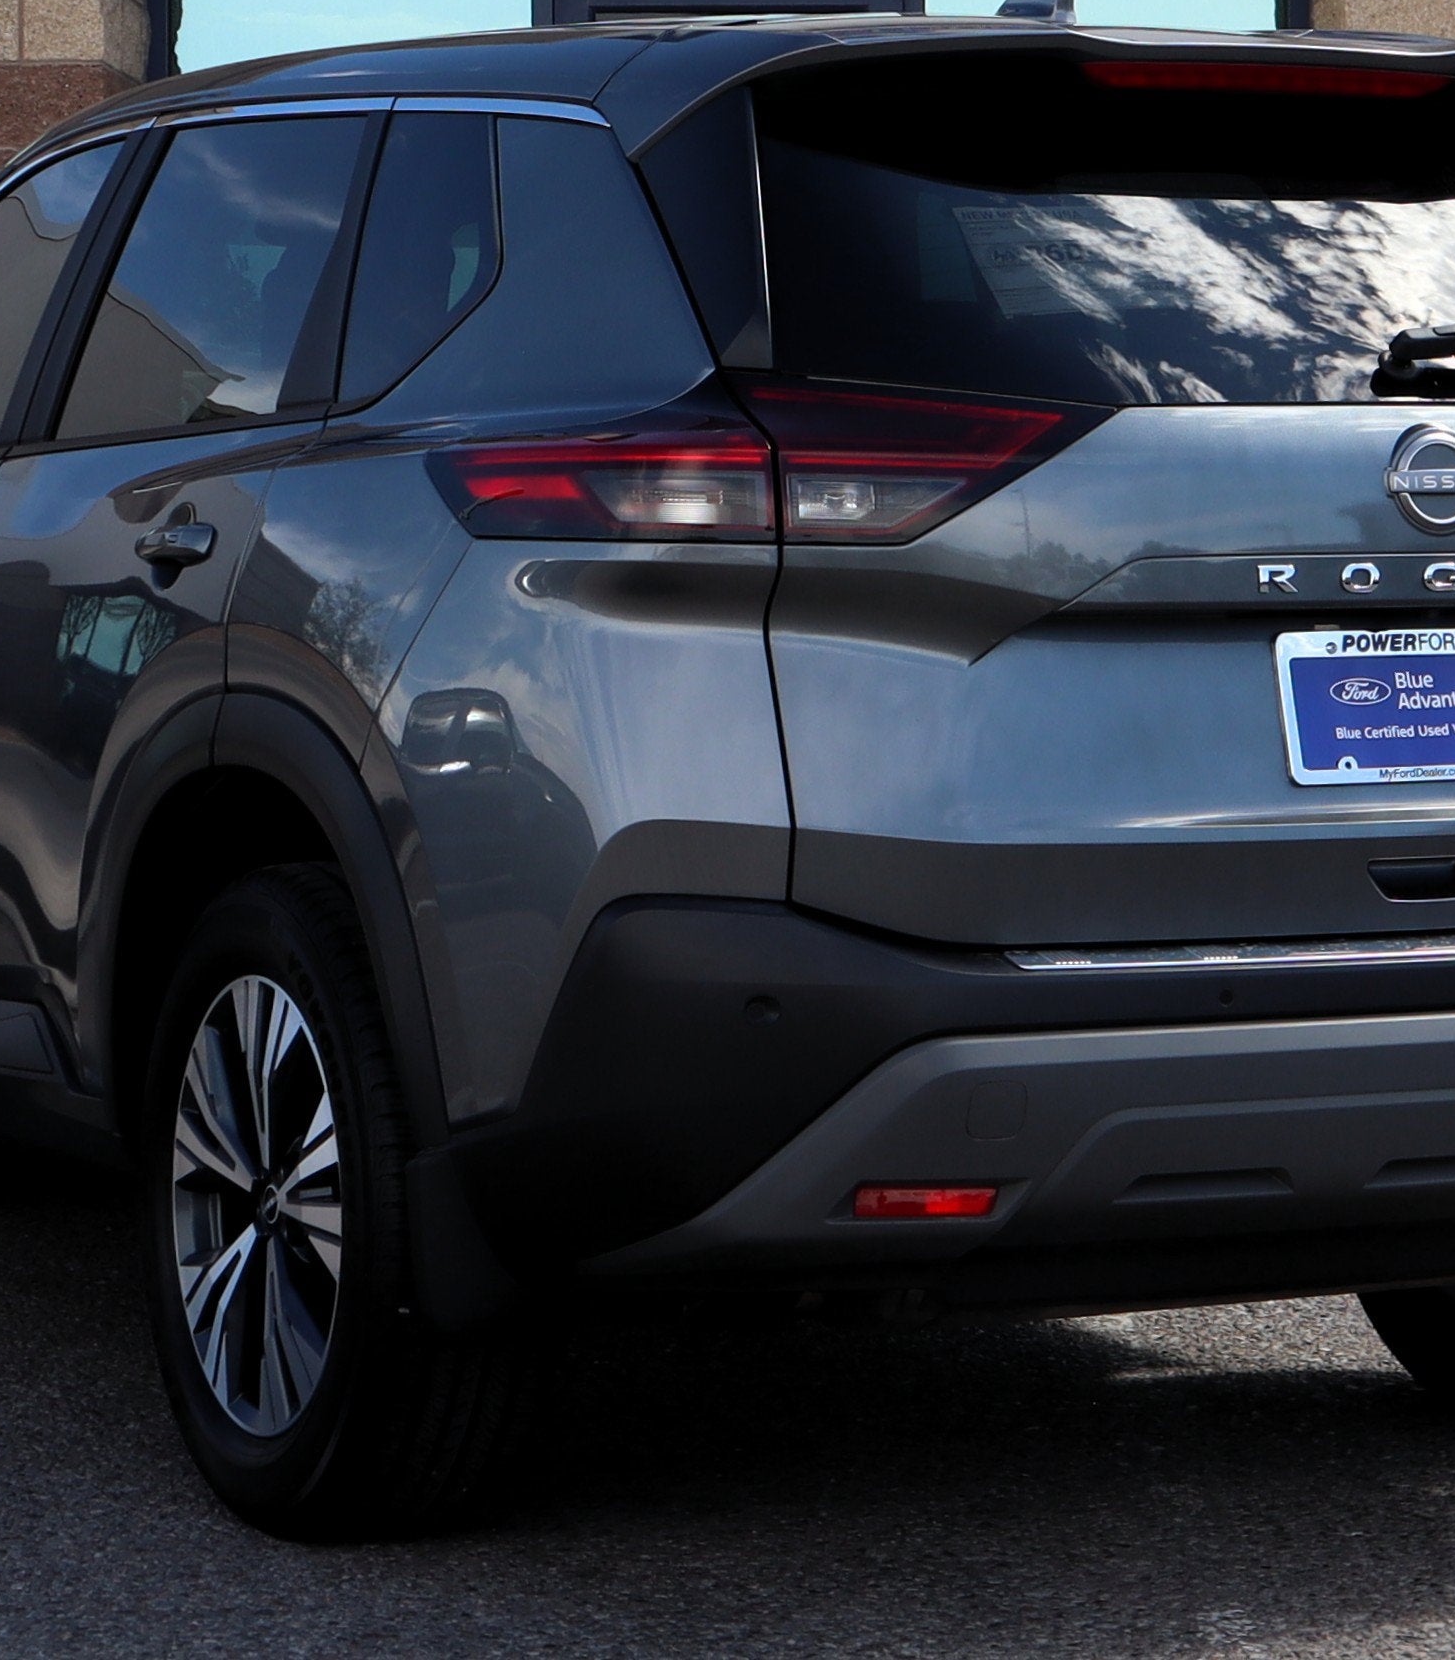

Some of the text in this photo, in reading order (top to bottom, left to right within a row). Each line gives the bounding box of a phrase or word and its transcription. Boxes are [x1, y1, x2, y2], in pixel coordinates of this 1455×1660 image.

[1394, 671, 1434, 689] Blue
[1341, 681, 1380, 701] Ford
[1335, 727, 1362, 740] Blue
[1364, 725, 1415, 739] Certified
[1418, 724, 1449, 737] Used
